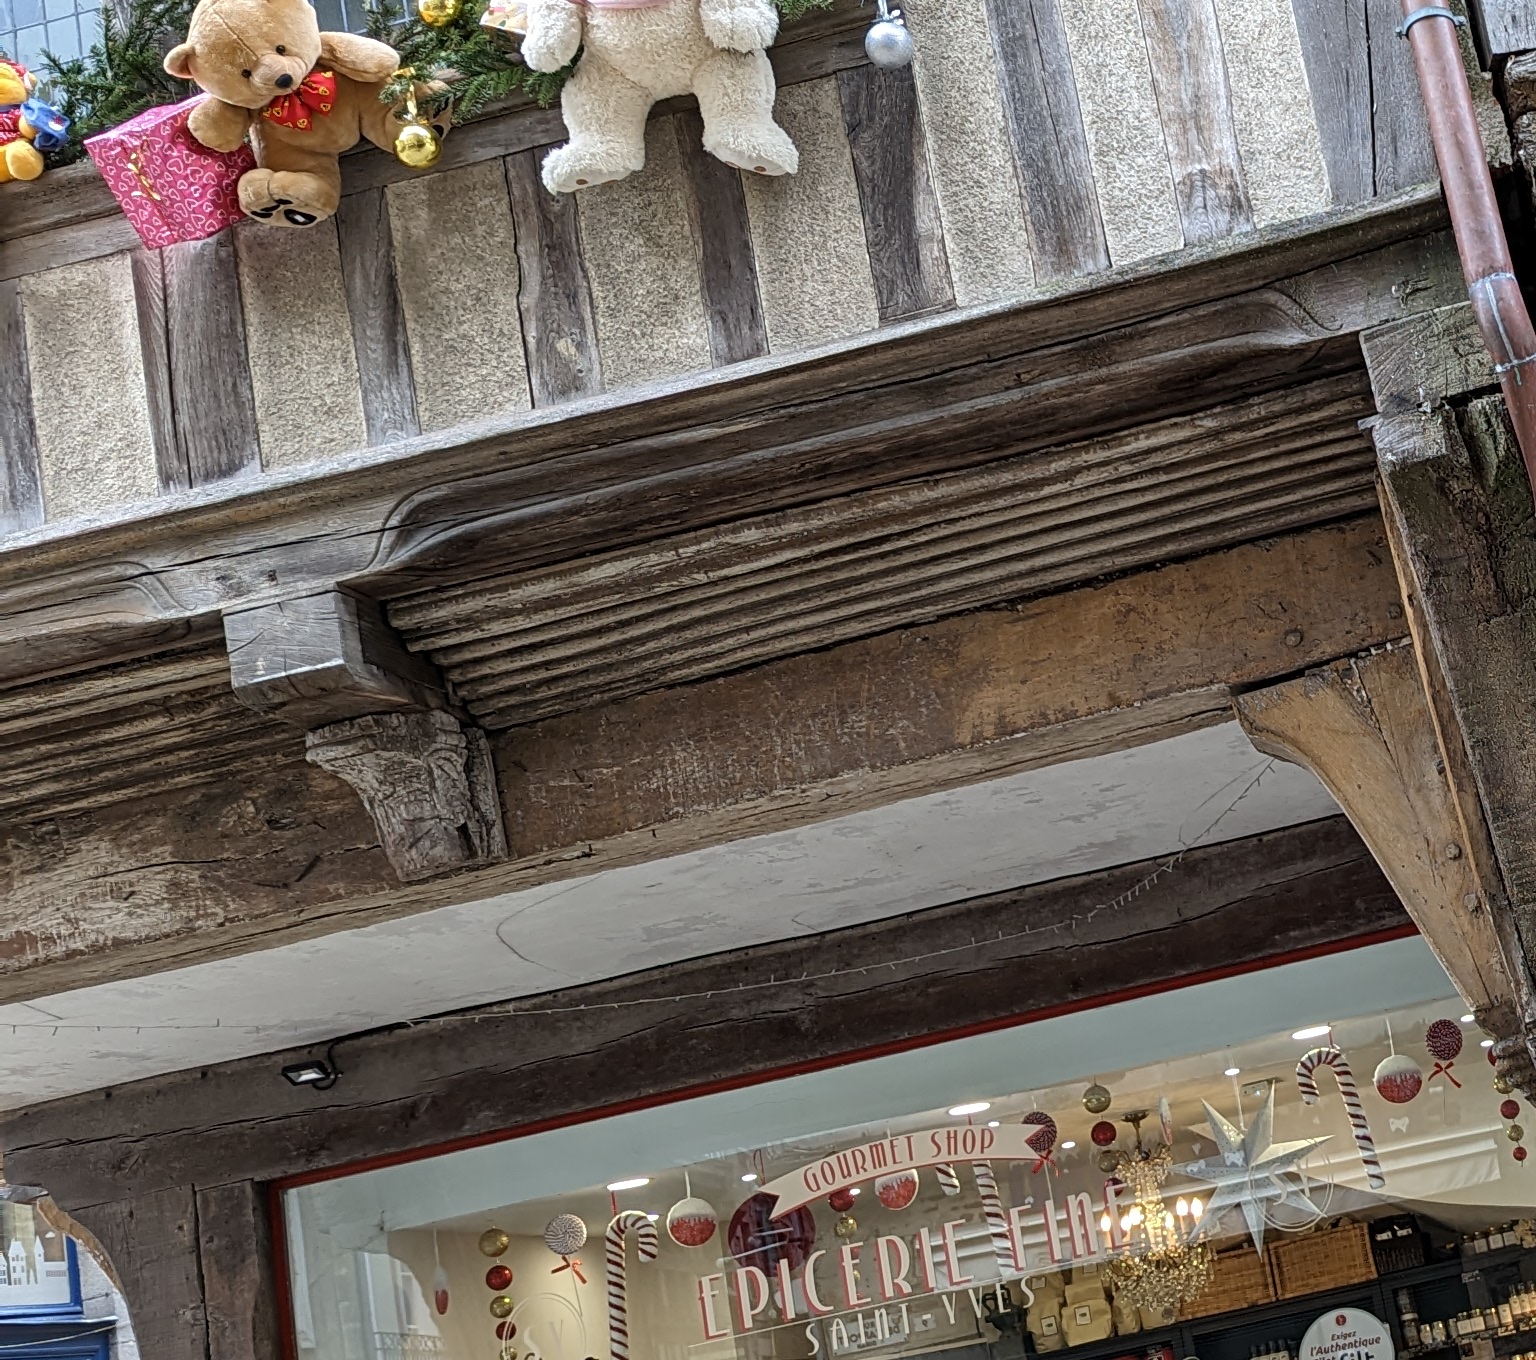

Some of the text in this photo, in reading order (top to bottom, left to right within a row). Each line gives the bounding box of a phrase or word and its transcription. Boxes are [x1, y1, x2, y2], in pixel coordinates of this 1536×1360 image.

[803, 1127, 995, 1194] GOURMET SHOP
[699, 1183, 1135, 1340] EPICERIE FINE
[805, 1275, 1036, 1357] SAINT-YVES
[1310, 1336, 1381, 1357] l'Authentique
[1331, 1330, 1357, 1341] Exigez
